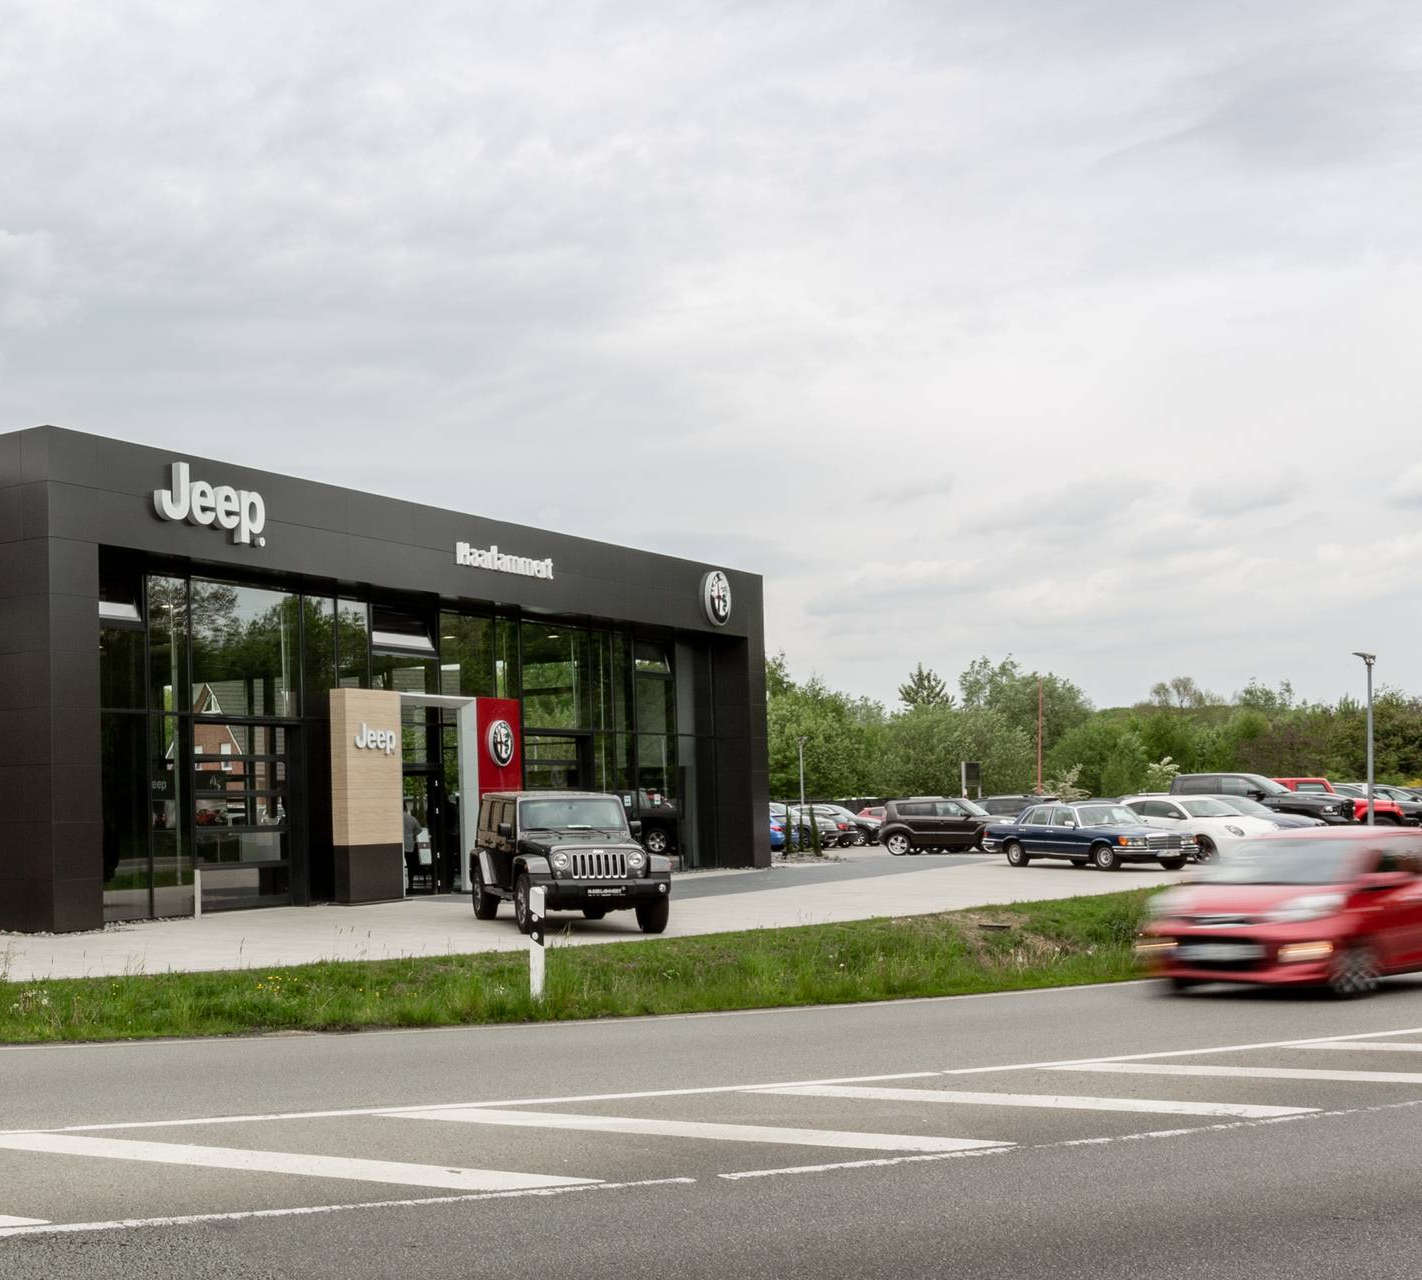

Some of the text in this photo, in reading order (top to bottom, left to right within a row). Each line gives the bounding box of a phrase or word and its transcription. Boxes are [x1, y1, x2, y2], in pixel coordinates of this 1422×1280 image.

[154, 461, 266, 547] Jeep
[354, 721, 397, 755] Jeep
[151, 780, 168, 792] eep
